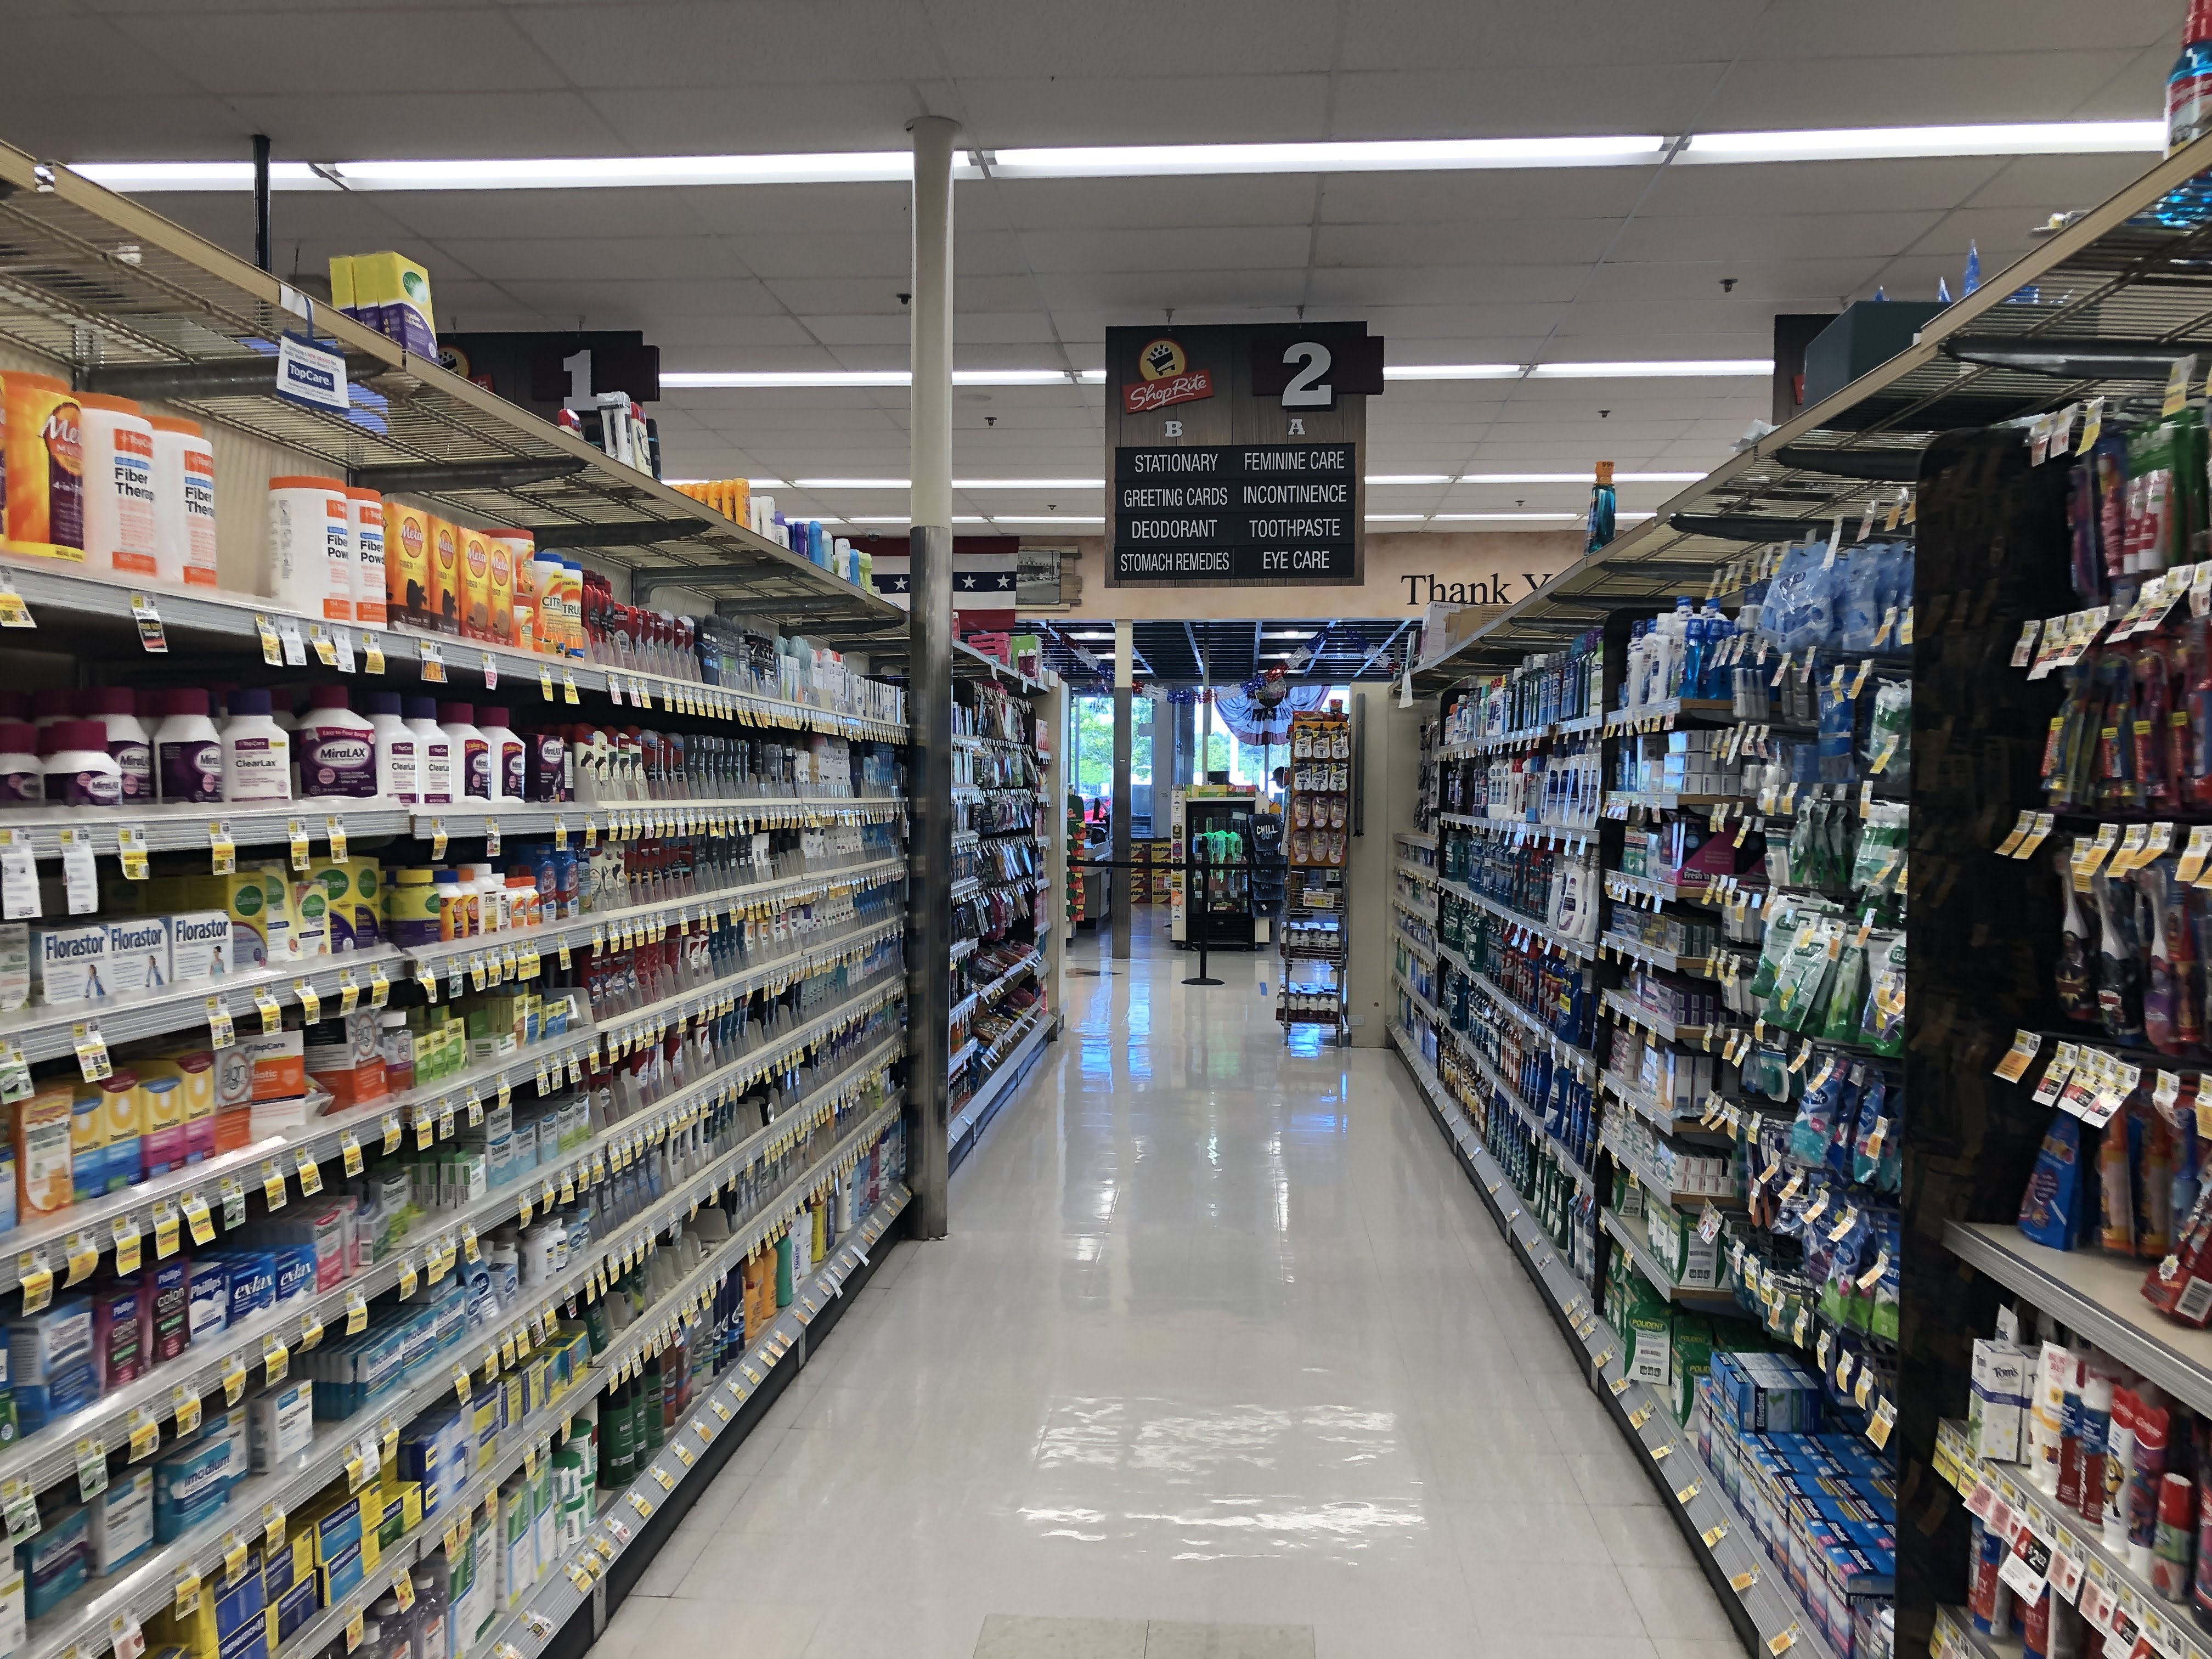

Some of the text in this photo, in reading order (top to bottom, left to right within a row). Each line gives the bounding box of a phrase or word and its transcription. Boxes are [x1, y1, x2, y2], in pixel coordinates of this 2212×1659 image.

[290, 363, 330, 385] TopCare
[563, 349, 598, 411] 1
[1282, 342, 1331, 406] 2
[1130, 373, 1206, 410] ShopRite
[1165, 421, 1183, 437] B
[1288, 419, 1305, 435] A
[1135, 453, 1218, 472] STATIONARY
[1244, 450, 1345, 471] FEMININE CARE
[115, 467, 148, 484] Fiber
[115, 482, 155, 502] Therap
[185, 487, 212, 503] Fiber
[1124, 487, 1228, 507] GREETING CARDS
[1243, 484, 1347, 504] INCONTINENCE
[185, 500, 215, 517] Thera
[401, 524, 423, 541] Meta
[1132, 520, 1217, 539] DEODORANT
[1249, 518, 1340, 538] TOOTHPASTE
[327, 534, 348, 548] Fibe
[439, 537, 454, 554] Meta
[328, 547, 349, 560] Pow
[467, 548, 487, 564] Meta
[1120, 552, 1229, 572] STOMACH REMEDIES
[1263, 551, 1330, 569] EYE CARE
[492, 556, 509, 572] Meta
[1401, 573, 1513, 605] Thank
[541, 596, 561, 610] CITR
[562, 604, 581, 615] TRUC
[320, 748, 366, 759] MiraLAX
[236, 759, 276, 768] ClearLax
[1256, 824, 1278, 835] CHILL
[111, 927, 162, 952] Florastor
[176, 919, 228, 943] Florastor
[46, 935, 104, 961] Florastor
[1632, 1319, 1664, 1330] POLIDENT
[1992, 1367, 2019, 1379] Tom's
